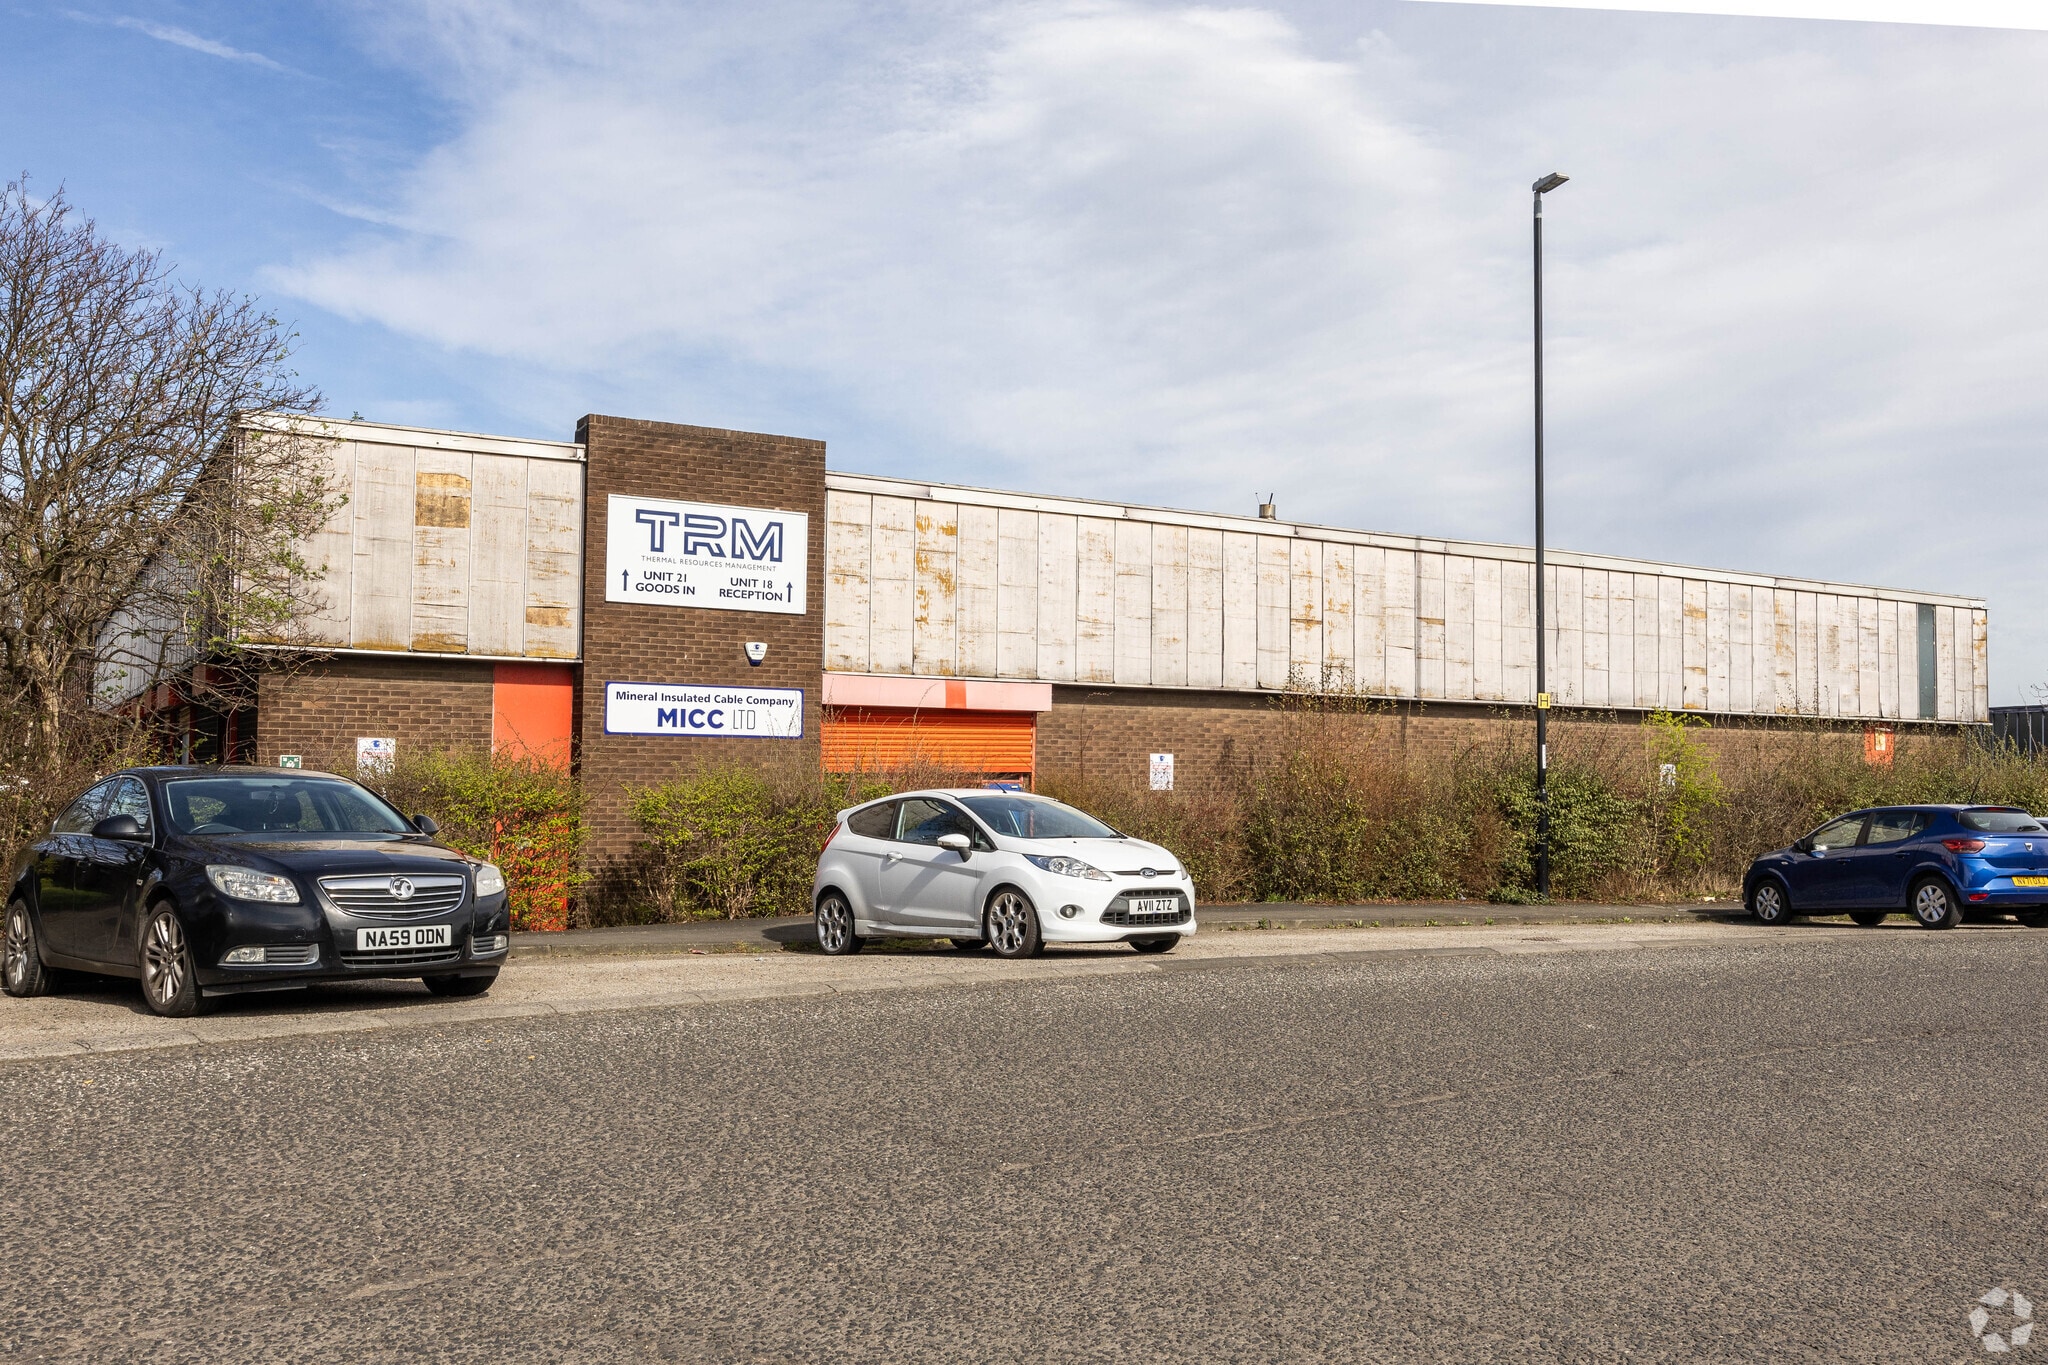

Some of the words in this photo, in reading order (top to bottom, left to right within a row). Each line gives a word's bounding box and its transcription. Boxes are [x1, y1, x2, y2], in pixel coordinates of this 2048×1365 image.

[635, 509, 783, 562] TRM
[641, 555, 677, 565] THERMAL
[679, 558, 723, 569] RESOURCES
[725, 562, 777, 572] MANAGEMENT
[643, 571, 674, 582] UNIT
[676, 573, 687, 583] 21
[730, 577, 759, 588] UNIT
[762, 579, 773, 590] 18
[635, 582, 680, 595] GOODS
[683, 585, 696, 596] IN
[719, 588, 783, 602] RECEPTION
[615, 690, 658, 702] Mineral
[661, 692, 711, 704] Insulated
[714, 694, 743, 705] Cable
[746, 695, 795, 708] Company
[1540, 695, 1548, 707] H
[657, 707, 725, 730] MICC
[732, 709, 756, 730] LTD
[1156, 899, 1172, 911] ZTZ
[366, 930, 410, 947] NA59
